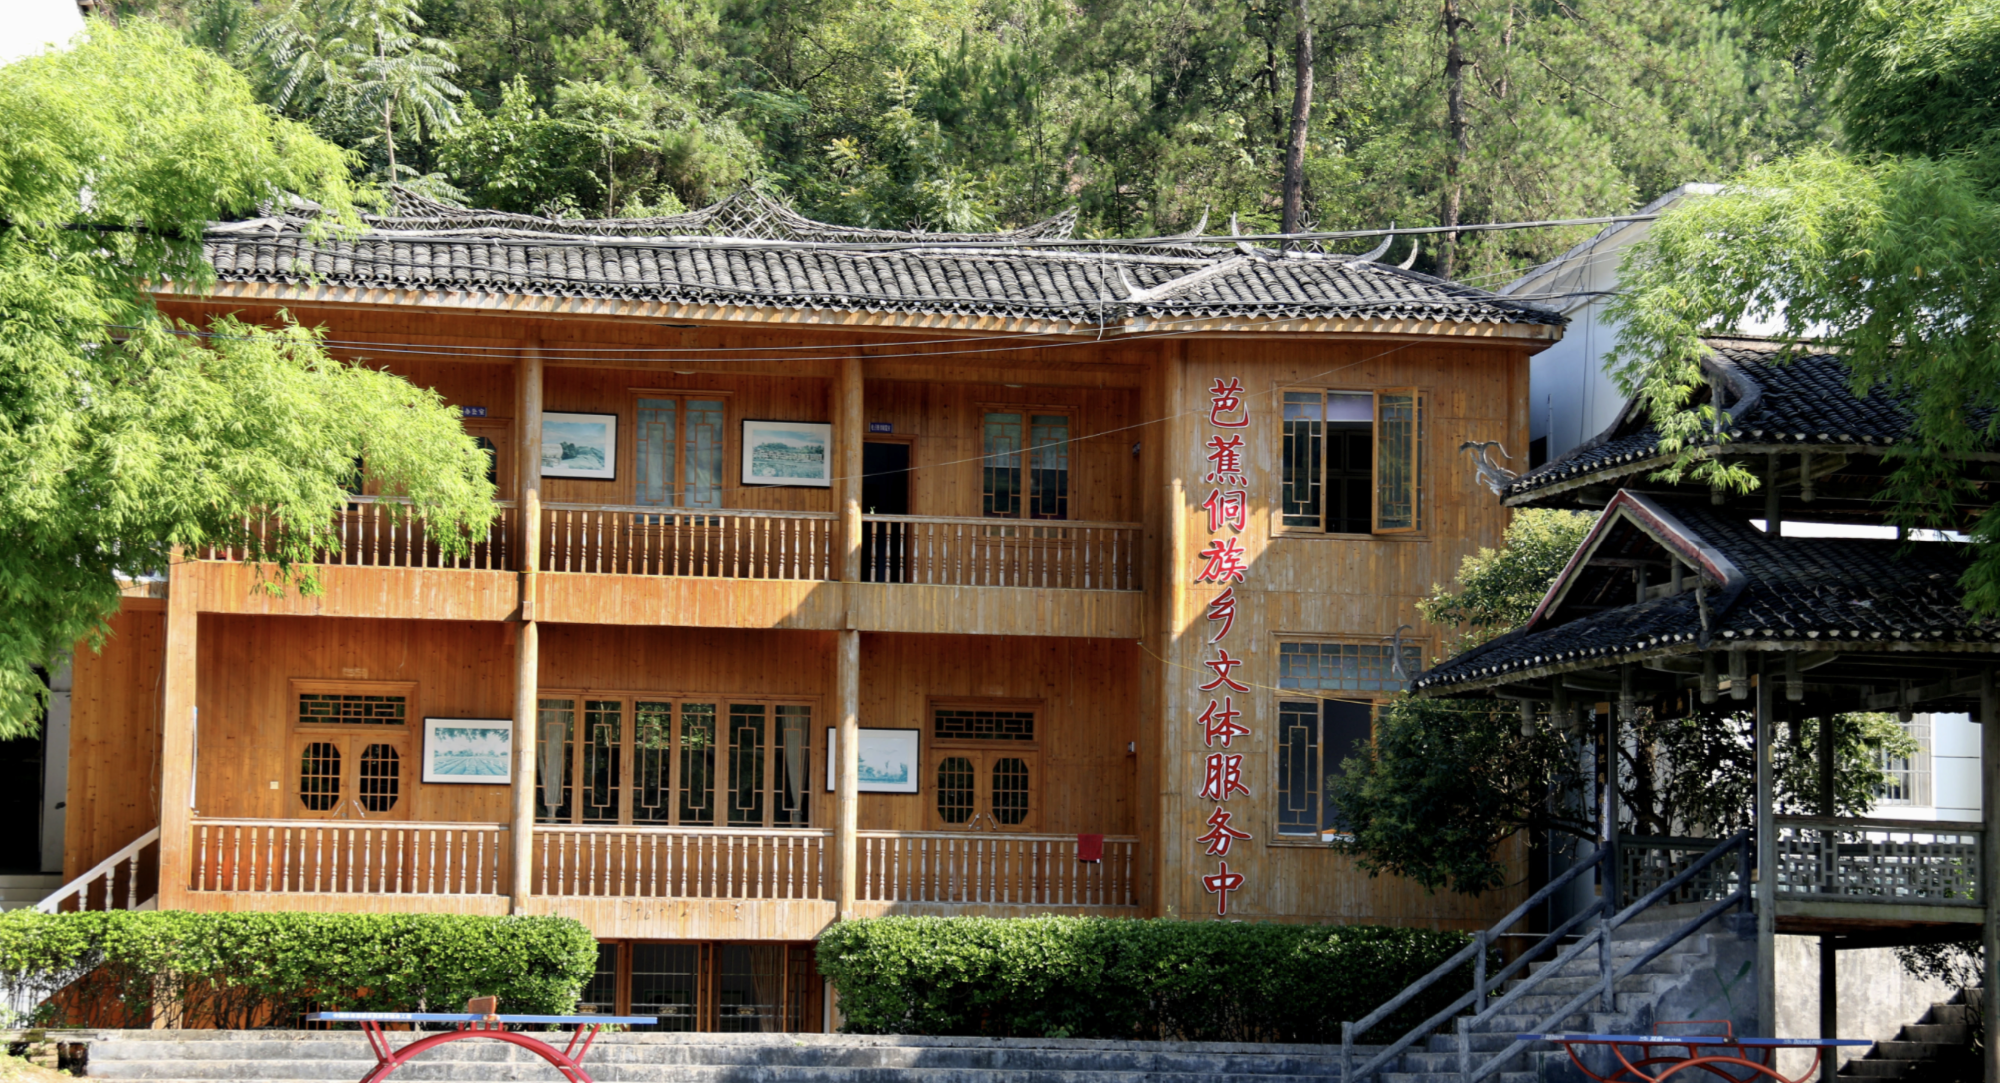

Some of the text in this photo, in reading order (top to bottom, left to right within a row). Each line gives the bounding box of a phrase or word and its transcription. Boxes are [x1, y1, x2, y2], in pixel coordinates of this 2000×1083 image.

[1196, 377, 1252, 922] 芭蕉侗族乡文体服务中
